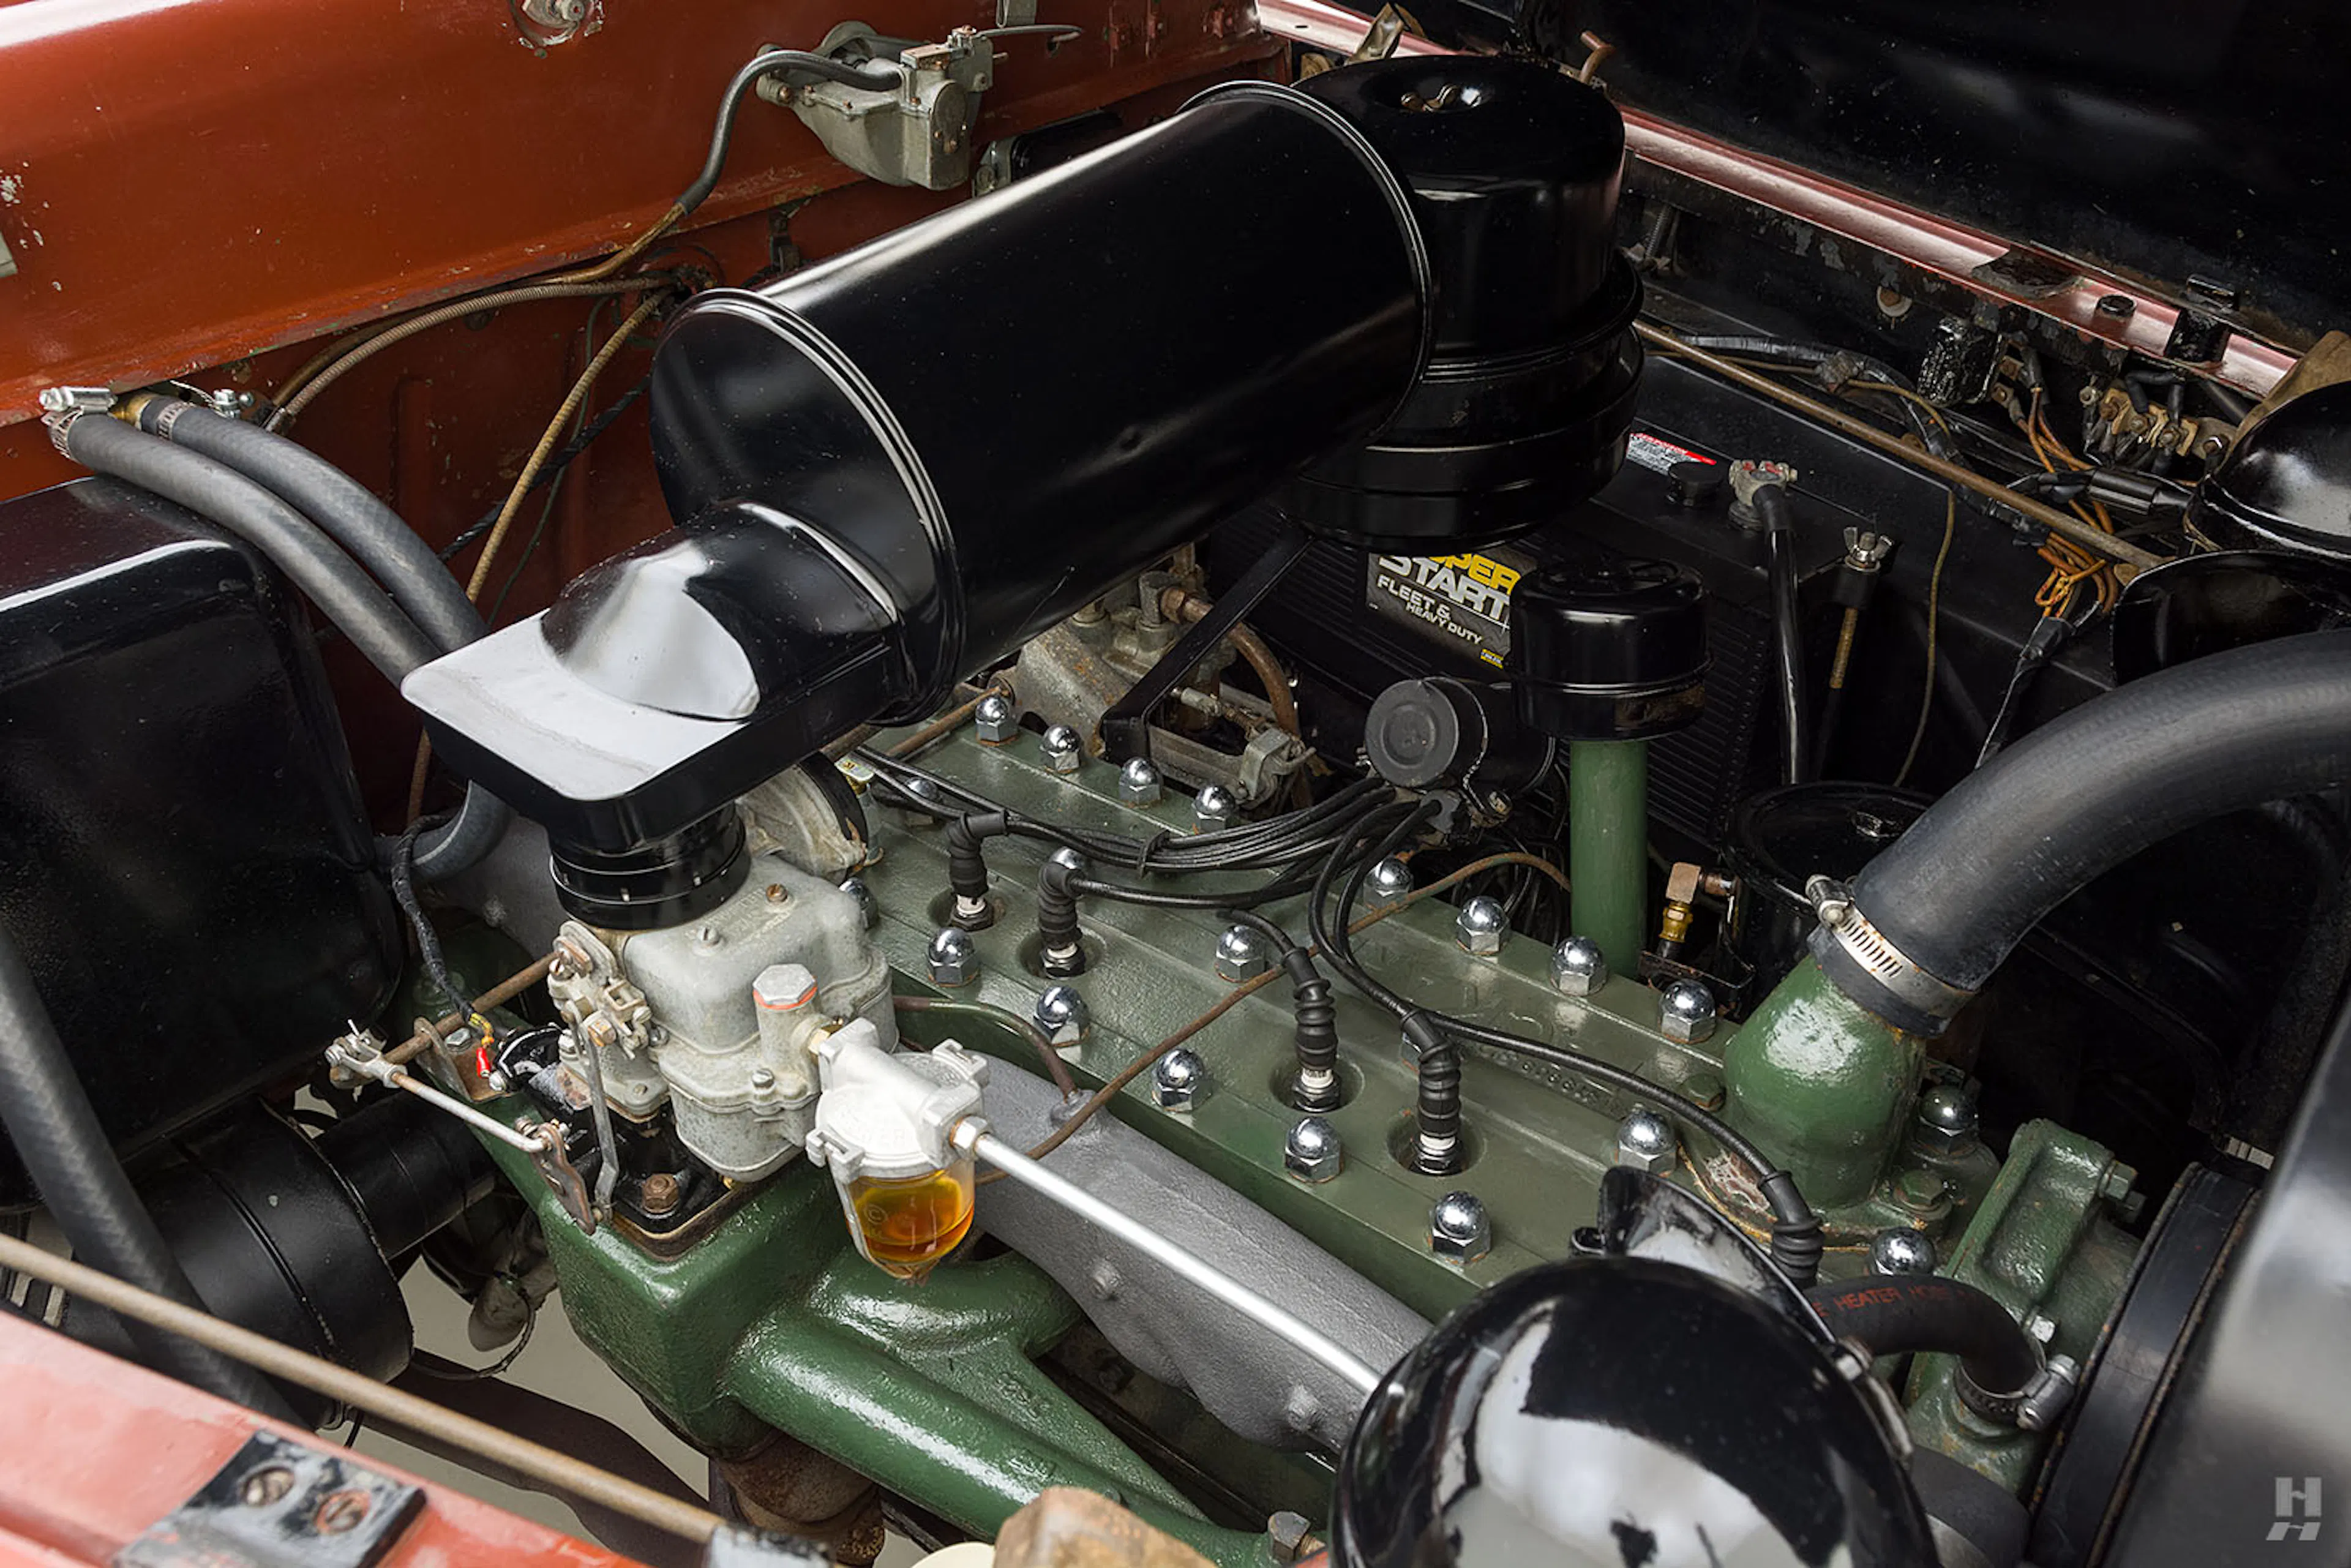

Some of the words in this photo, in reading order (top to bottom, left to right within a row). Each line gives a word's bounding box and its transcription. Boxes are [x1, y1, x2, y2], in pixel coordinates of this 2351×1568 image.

[1378, 574, 1436, 610] FLEET
[1436, 604, 1452, 622] &
[1379, 555, 1510, 620] START
[1406, 602, 1447, 628] HEAVY
[1447, 621, 1483, 645] DUTY
[1832, 1286, 1904, 1311] HEATER
